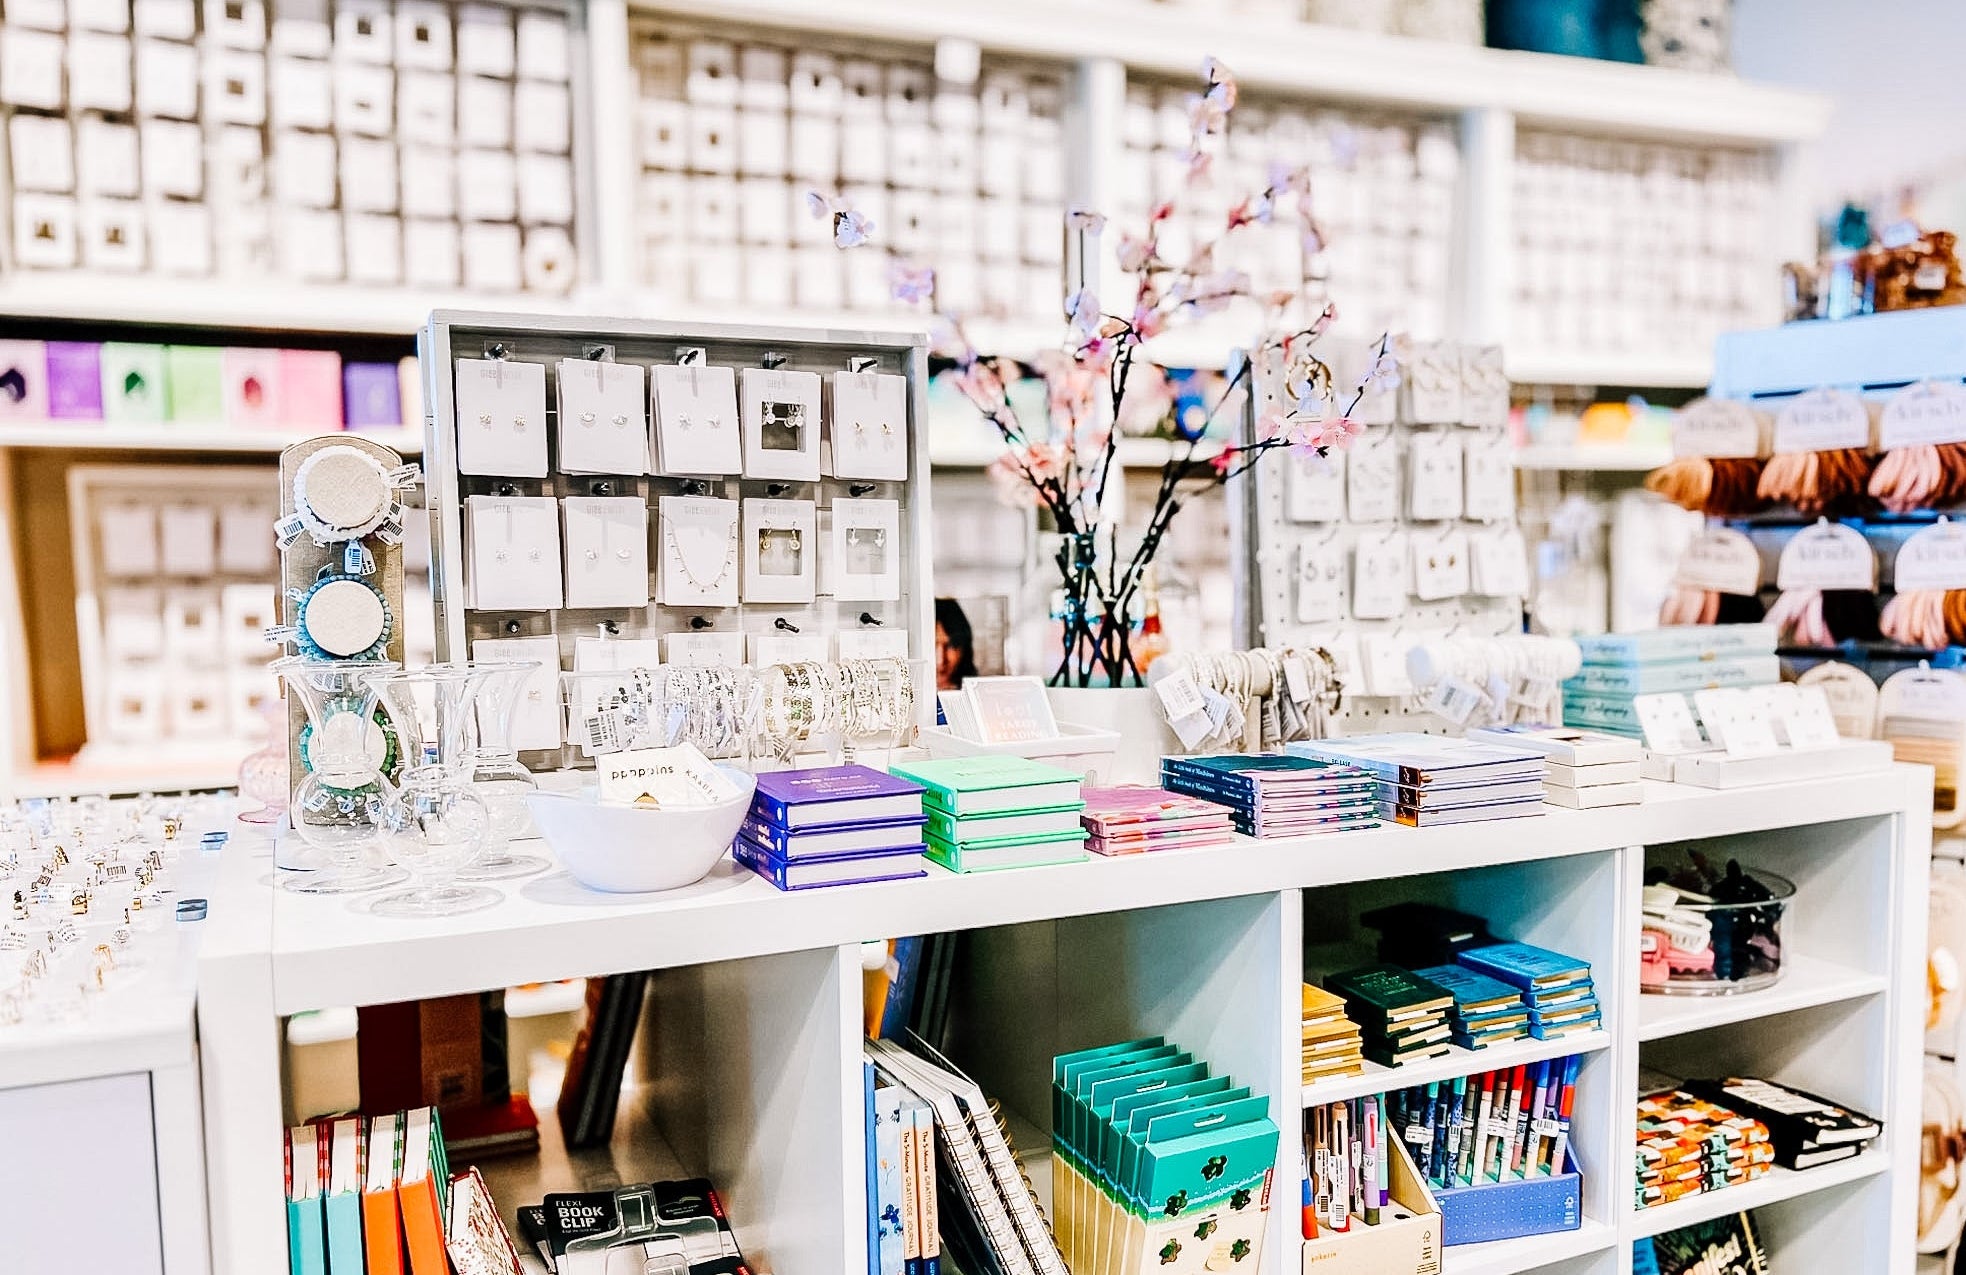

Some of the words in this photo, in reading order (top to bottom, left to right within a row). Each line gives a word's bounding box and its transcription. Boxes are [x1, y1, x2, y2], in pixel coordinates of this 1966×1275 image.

[558, 1206, 604, 1218] BOOK
[905, 1176, 914, 1217] GRATITUDE
[924, 1175, 933, 1216] GRATITUDE
[561, 1217, 596, 1229] CLIP
[926, 1219, 934, 1253] JOURNAL
